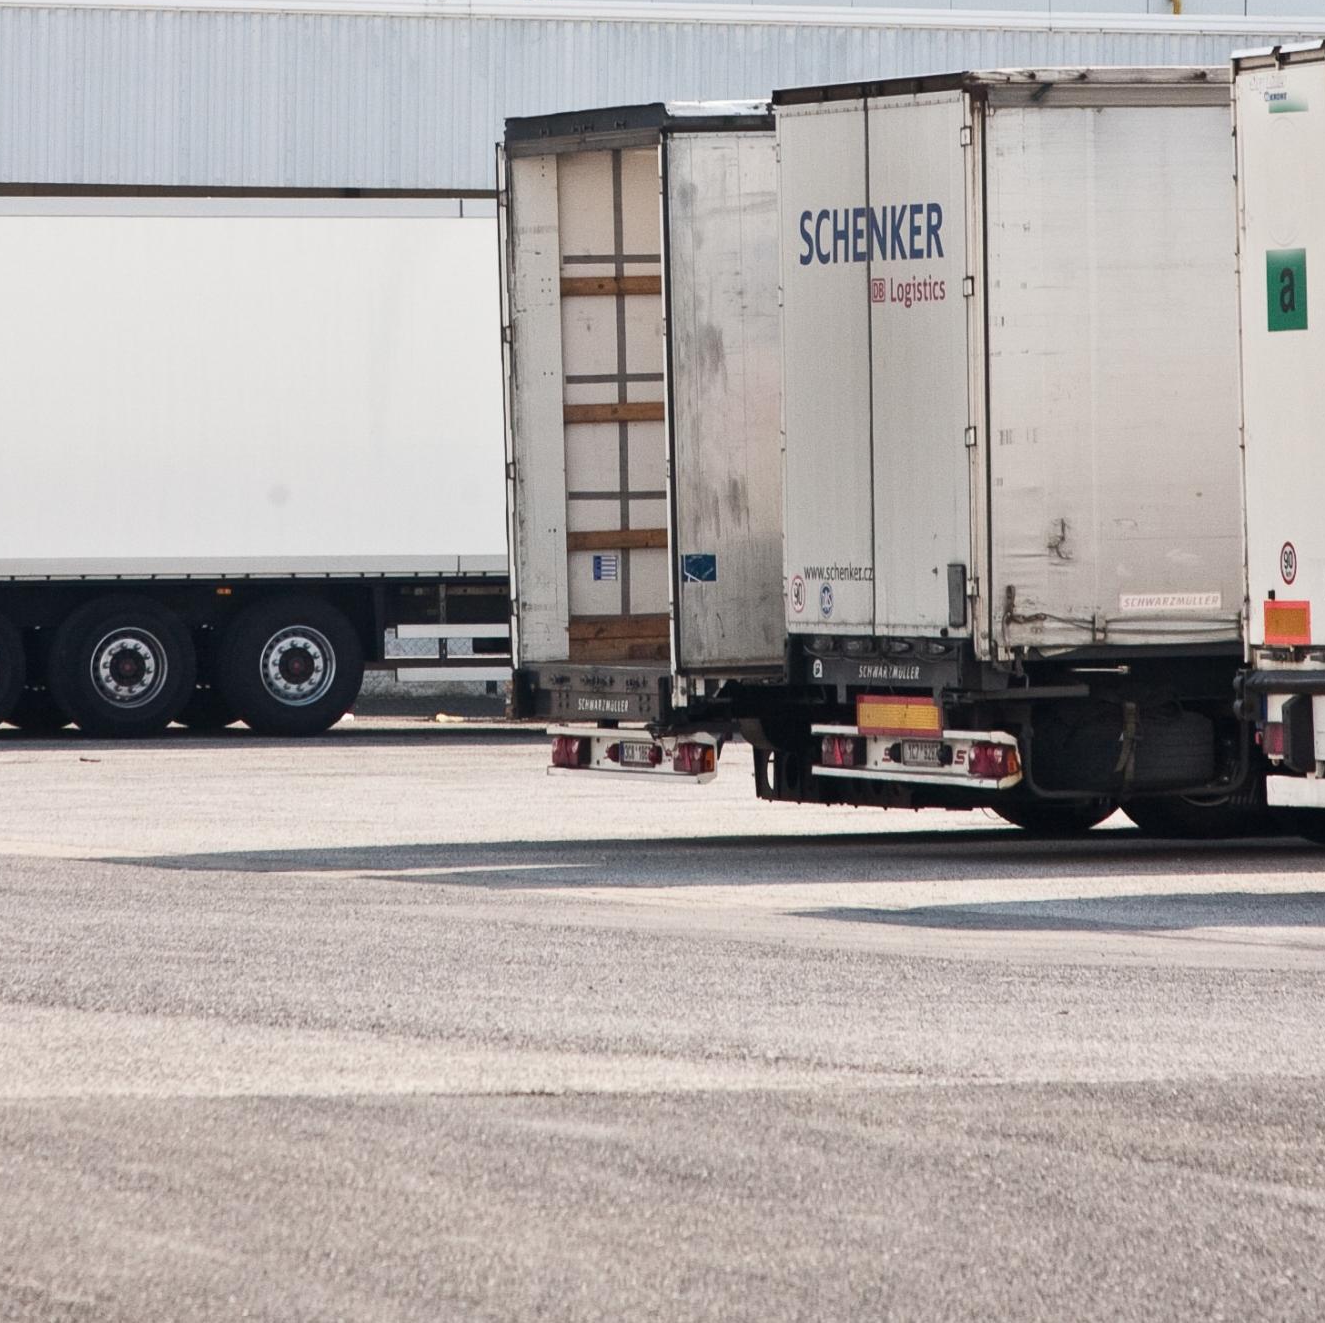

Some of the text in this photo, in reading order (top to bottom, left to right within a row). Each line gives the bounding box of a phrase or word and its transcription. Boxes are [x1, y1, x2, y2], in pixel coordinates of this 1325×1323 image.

[800, 203, 944, 266] SCHENKER
[872, 276, 946, 308] DB Logistics
[803, 562, 873, 581] www.schenker.cz
[1284, 550, 1293, 569] 90
